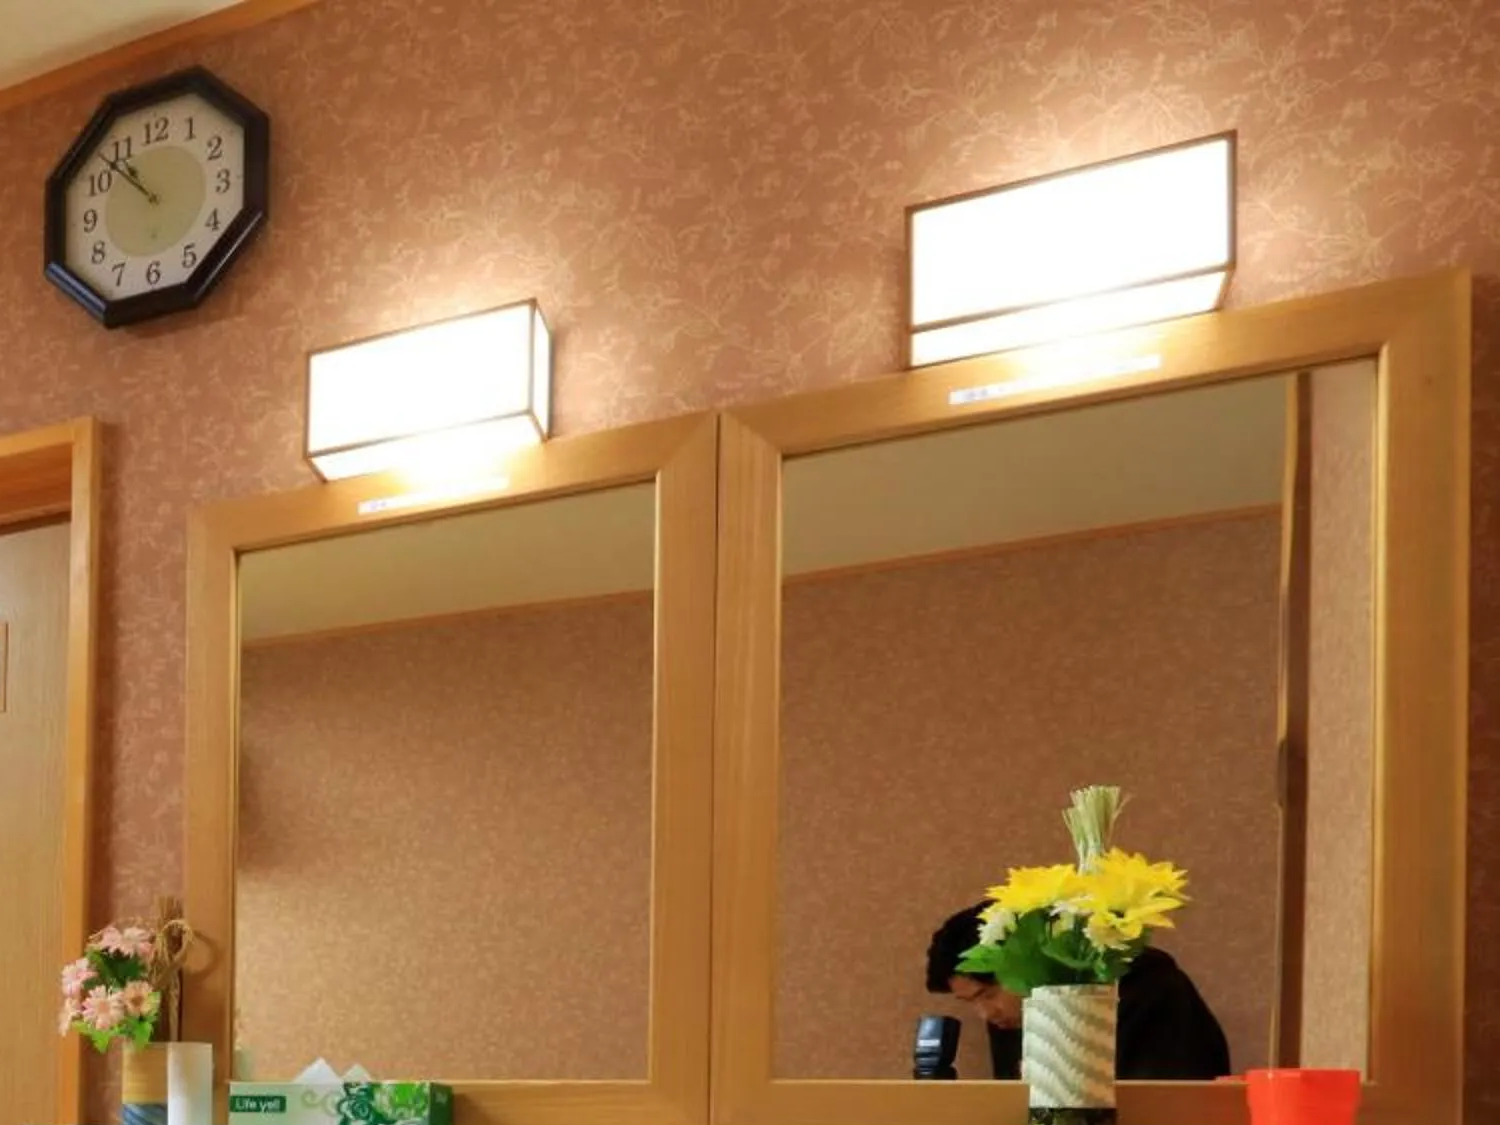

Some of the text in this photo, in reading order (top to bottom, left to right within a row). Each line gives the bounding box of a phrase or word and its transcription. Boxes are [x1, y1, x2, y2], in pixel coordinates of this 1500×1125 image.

[143, 117, 169, 145] 12
[185, 117, 197, 139] 1
[113, 136, 133, 161] 11
[207, 136, 223, 161] 2
[88, 170, 112, 196] 10
[216, 169, 231, 193] 3
[83, 208, 98, 233] 9
[205, 208, 221, 231] 4
[91, 241, 106, 264] 8
[181, 243, 197, 268] 5
[112, 262, 126, 287] 7
[146, 261, 161, 285] 6
